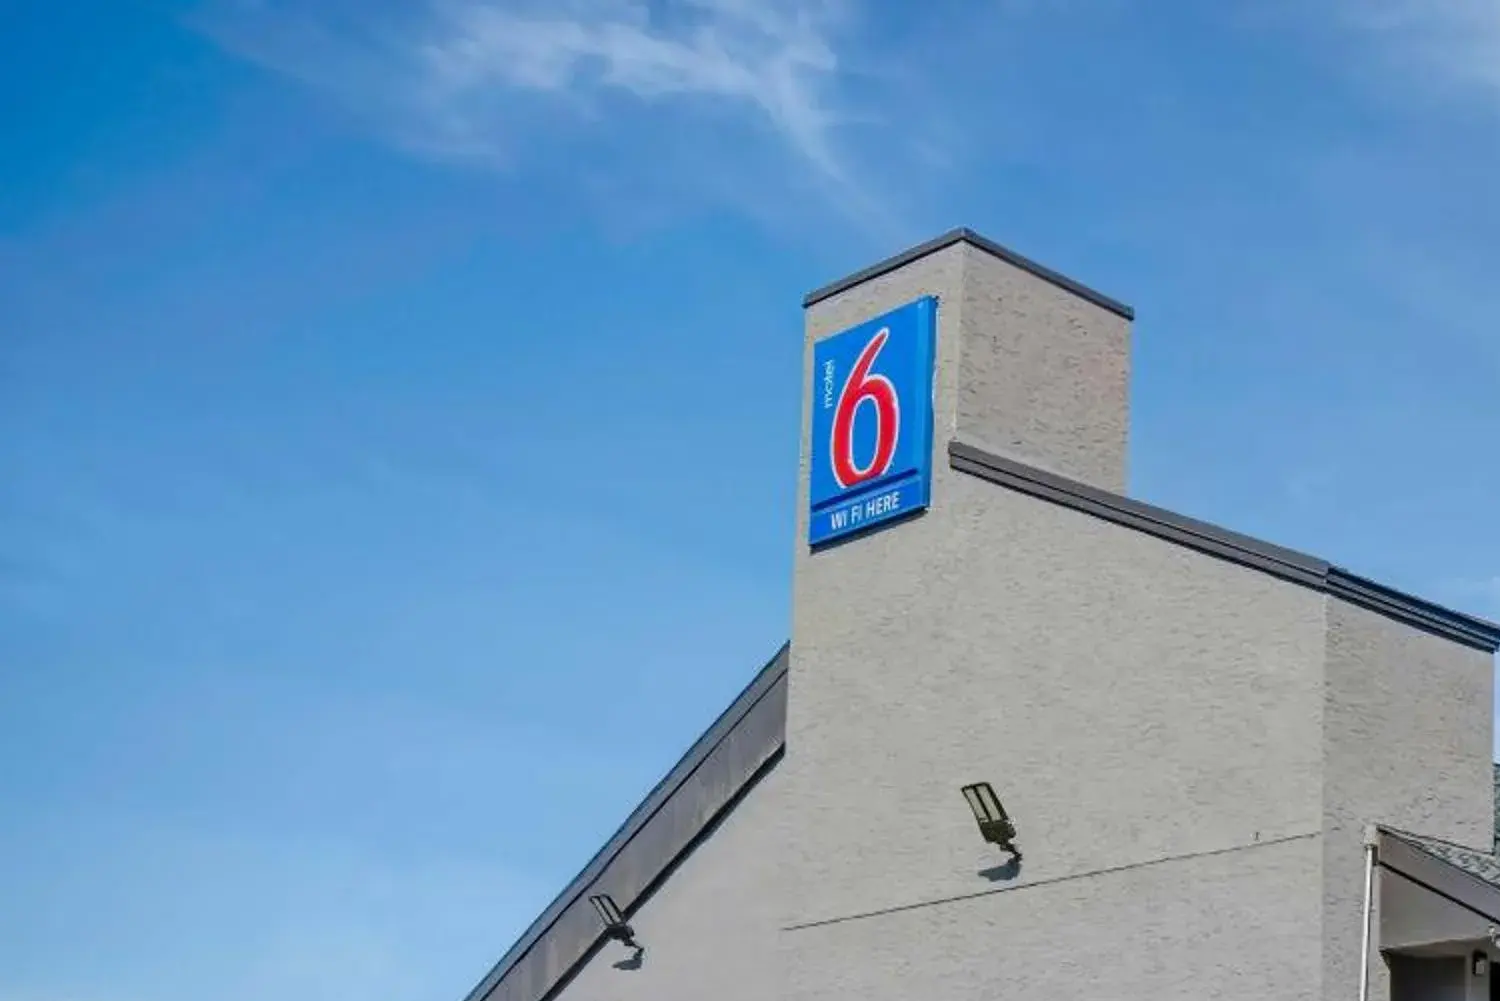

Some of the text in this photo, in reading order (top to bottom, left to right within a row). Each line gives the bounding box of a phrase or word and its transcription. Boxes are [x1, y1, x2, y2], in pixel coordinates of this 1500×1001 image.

[830, 327, 899, 489] 6
[831, 491, 900, 530] WI FI HERE
